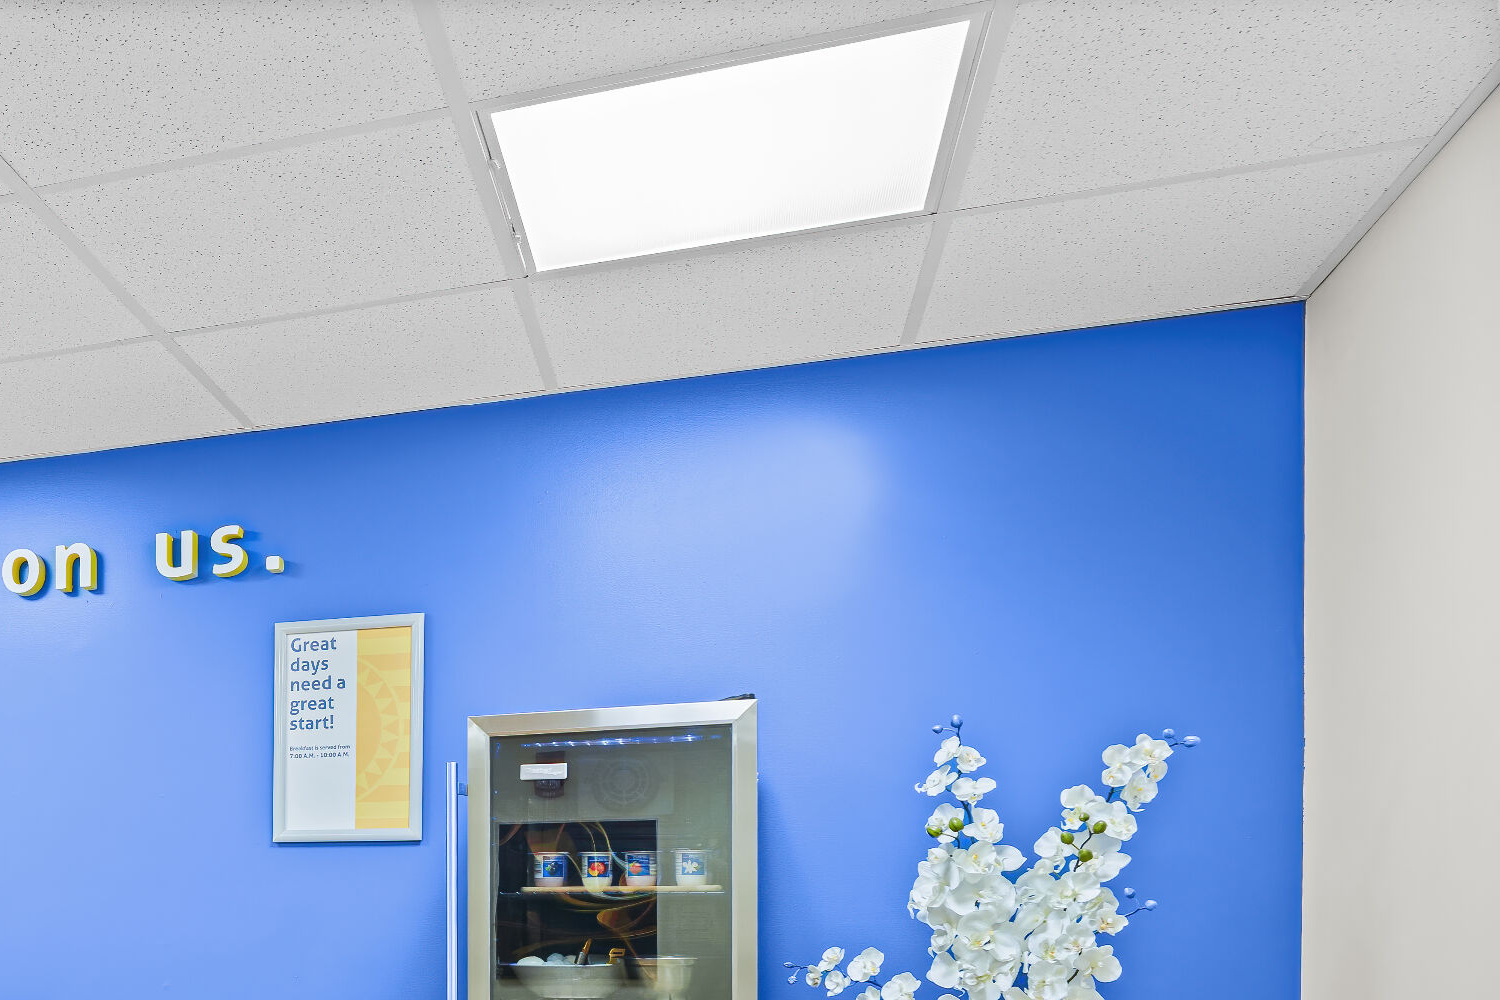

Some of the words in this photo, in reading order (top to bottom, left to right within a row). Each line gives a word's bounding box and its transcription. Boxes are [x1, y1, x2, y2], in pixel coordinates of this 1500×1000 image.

[1, 543, 98, 597] on
[155, 524, 285, 581] us.
[290, 636, 337, 653] Great
[290, 657, 329, 676] days
[290, 674, 332, 692] need
[336, 677, 346, 690] a
[289, 696, 335, 716] great
[289, 714, 334, 731] start!
